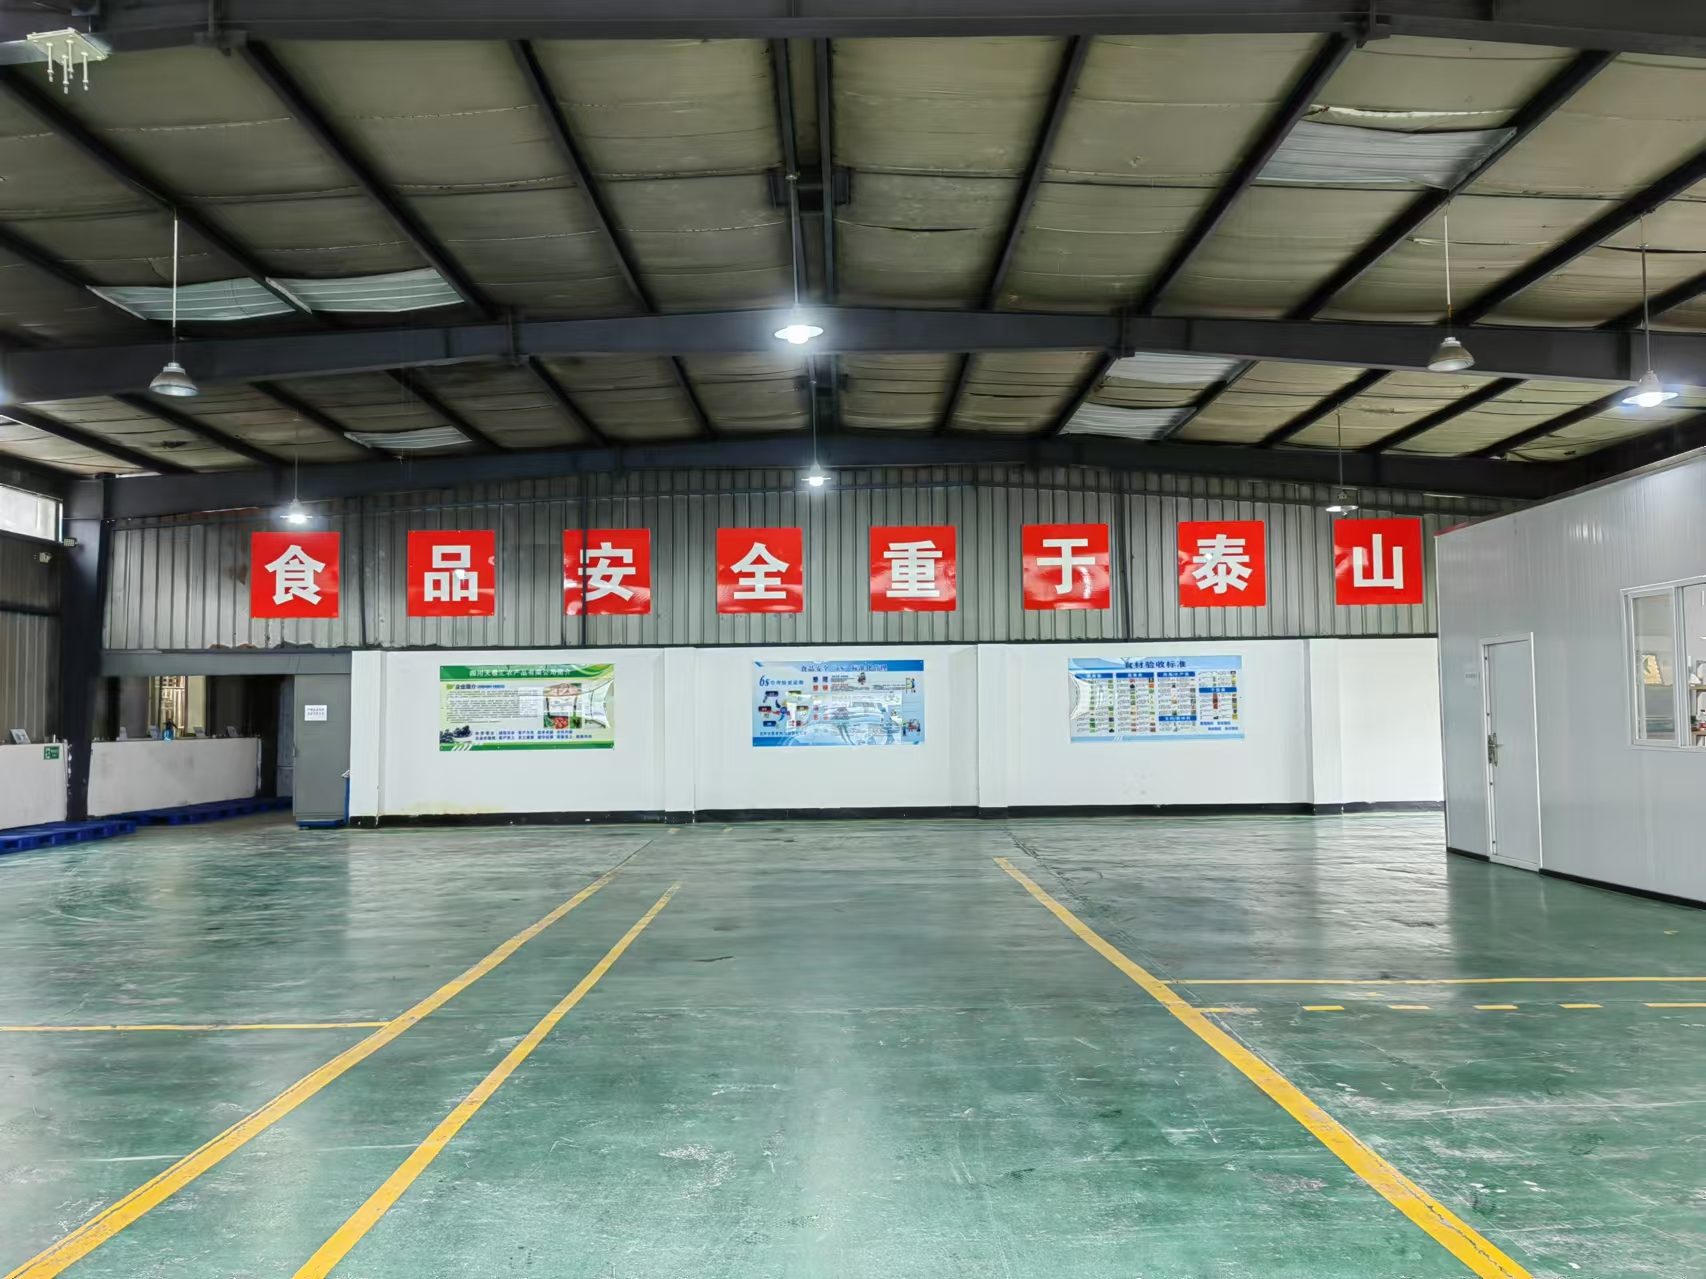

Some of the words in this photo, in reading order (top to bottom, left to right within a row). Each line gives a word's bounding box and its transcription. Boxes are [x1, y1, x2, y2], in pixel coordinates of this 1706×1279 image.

[264, 533, 1404, 606] 食品安全重于泰山
[1125, 660, 1187, 669] 食材验收标准
